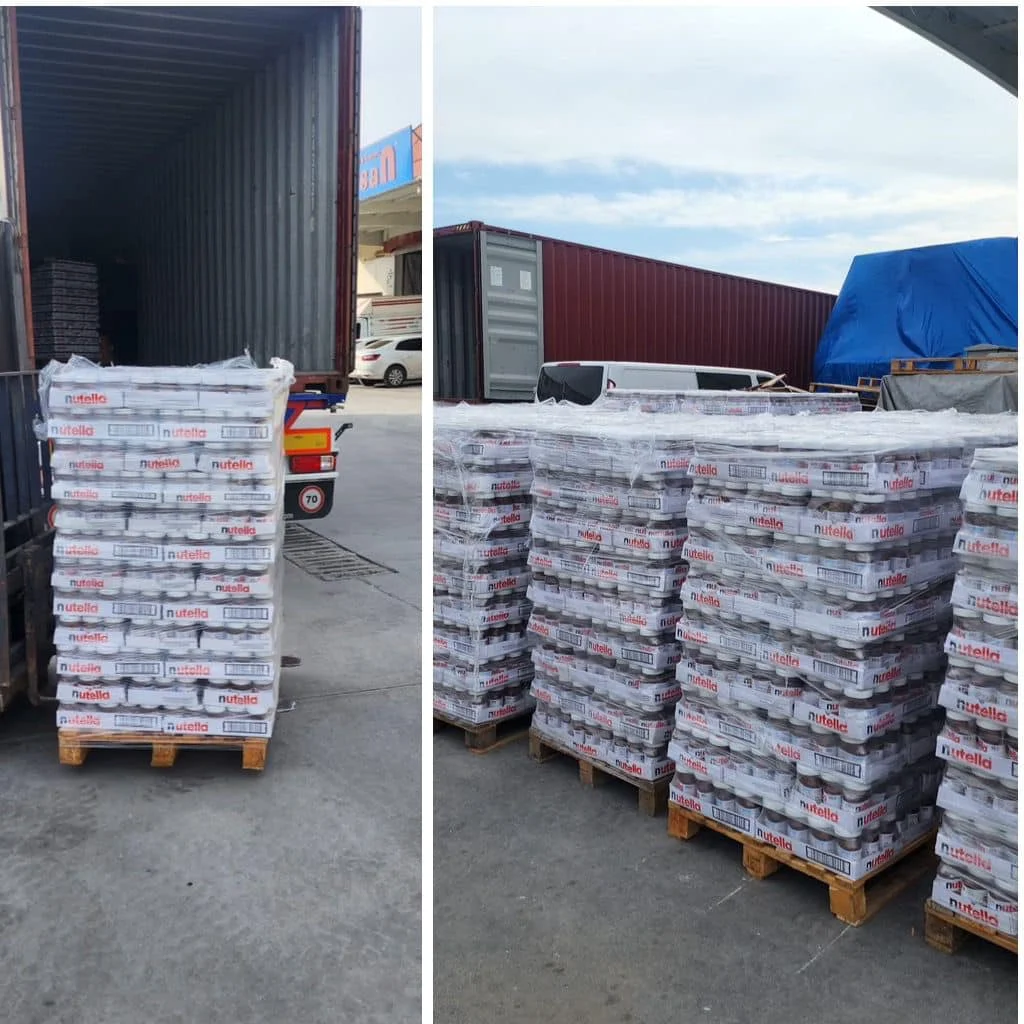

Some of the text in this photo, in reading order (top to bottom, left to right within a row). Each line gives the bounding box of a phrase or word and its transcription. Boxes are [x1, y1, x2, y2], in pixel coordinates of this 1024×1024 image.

[65, 394, 107, 404] nutella
[51, 425, 94, 436] nutella
[163, 427, 207, 438] nutella
[69, 460, 104, 470] nutella
[140, 458, 180, 469] nutella
[212, 459, 253, 470] nutella
[771, 471, 808, 484] nutella
[492, 481, 520, 491] nutella
[883, 479, 914, 490] nutella
[64, 489, 98, 500] nutella
[176, 493, 212, 502] nutella
[305, 495, 318, 503] 70
[750, 516, 783, 530] nutella
[221, 525, 256, 536] nutella
[578, 530, 602, 542] nutella
[814, 525, 854, 540] nutella
[872, 525, 904, 539] nutella
[624, 538, 651, 549] nutella
[958, 538, 1010, 558] nutella
[55, 544, 99, 556] nutella
[168, 549, 211, 561] nutella
[684, 547, 713, 561] nutella
[70, 578, 104, 588] nutella
[488, 578, 517, 591] nutella
[878, 574, 908, 587] nutella
[215, 584, 250, 593] nutella
[690, 593, 720, 607] nutella
[57, 602, 98, 614] nutella
[166, 608, 208, 619] nutella
[862, 621, 896, 636] nutella
[68, 632, 108, 642] nutella
[588, 640, 612, 655] nutella
[949, 640, 1000, 664] nutella
[60, 663, 101, 673] nutella
[169, 665, 210, 676] nutella
[873, 667, 901, 684] nutella
[688, 672, 717, 692] nutella
[72, 689, 110, 700] nutella
[218, 694, 258, 705] nutella
[956, 697, 1008, 723] nutella
[60, 716, 100, 725] nutella
[167, 721, 208, 731] nutella
[808, 711, 848, 733] nutella
[942, 744, 992, 770] nutella
[616, 758, 642, 774] nutella
[671, 791, 702, 811] nutella
[800, 800, 839, 822] nutella
[857, 806, 888, 827] nutella
[757, 828, 793, 851] nutella
[866, 848, 895, 871] nutella
[941, 842, 992, 872] nutella
[950, 896, 998, 926] nutella
